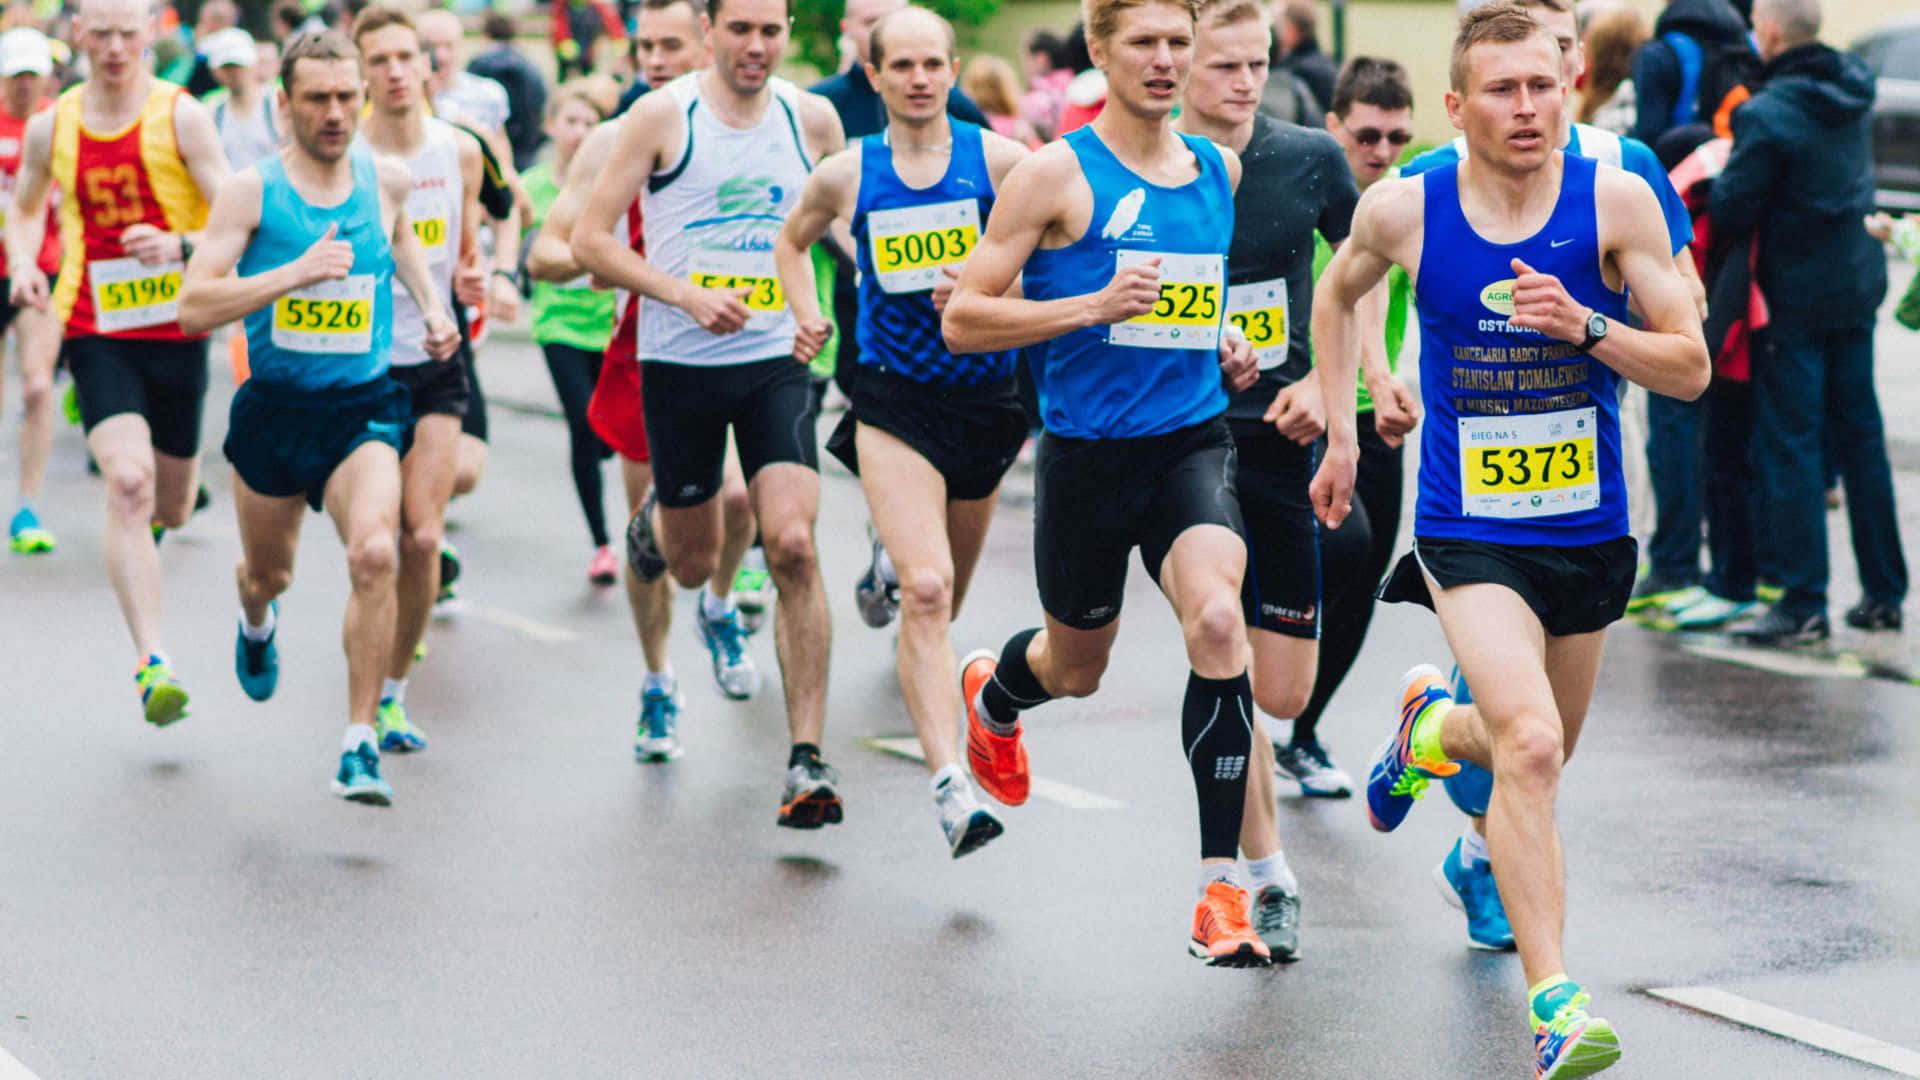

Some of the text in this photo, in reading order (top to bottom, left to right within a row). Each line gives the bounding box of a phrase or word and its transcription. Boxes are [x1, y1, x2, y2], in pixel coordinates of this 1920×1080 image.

[85, 163, 144, 228] 53
[885, 228, 966, 266] 5003
[107, 273, 175, 307] 5196
[1154, 284, 1216, 319] 525
[286, 299, 362, 328] 5526
[1230, 311, 1273, 342] 23
[1510, 346, 1540, 363] RADCY
[1471, 431, 1493, 441] BIEG
[1495, 431, 1509, 440] NA
[1481, 442, 1581, 486] 5373
